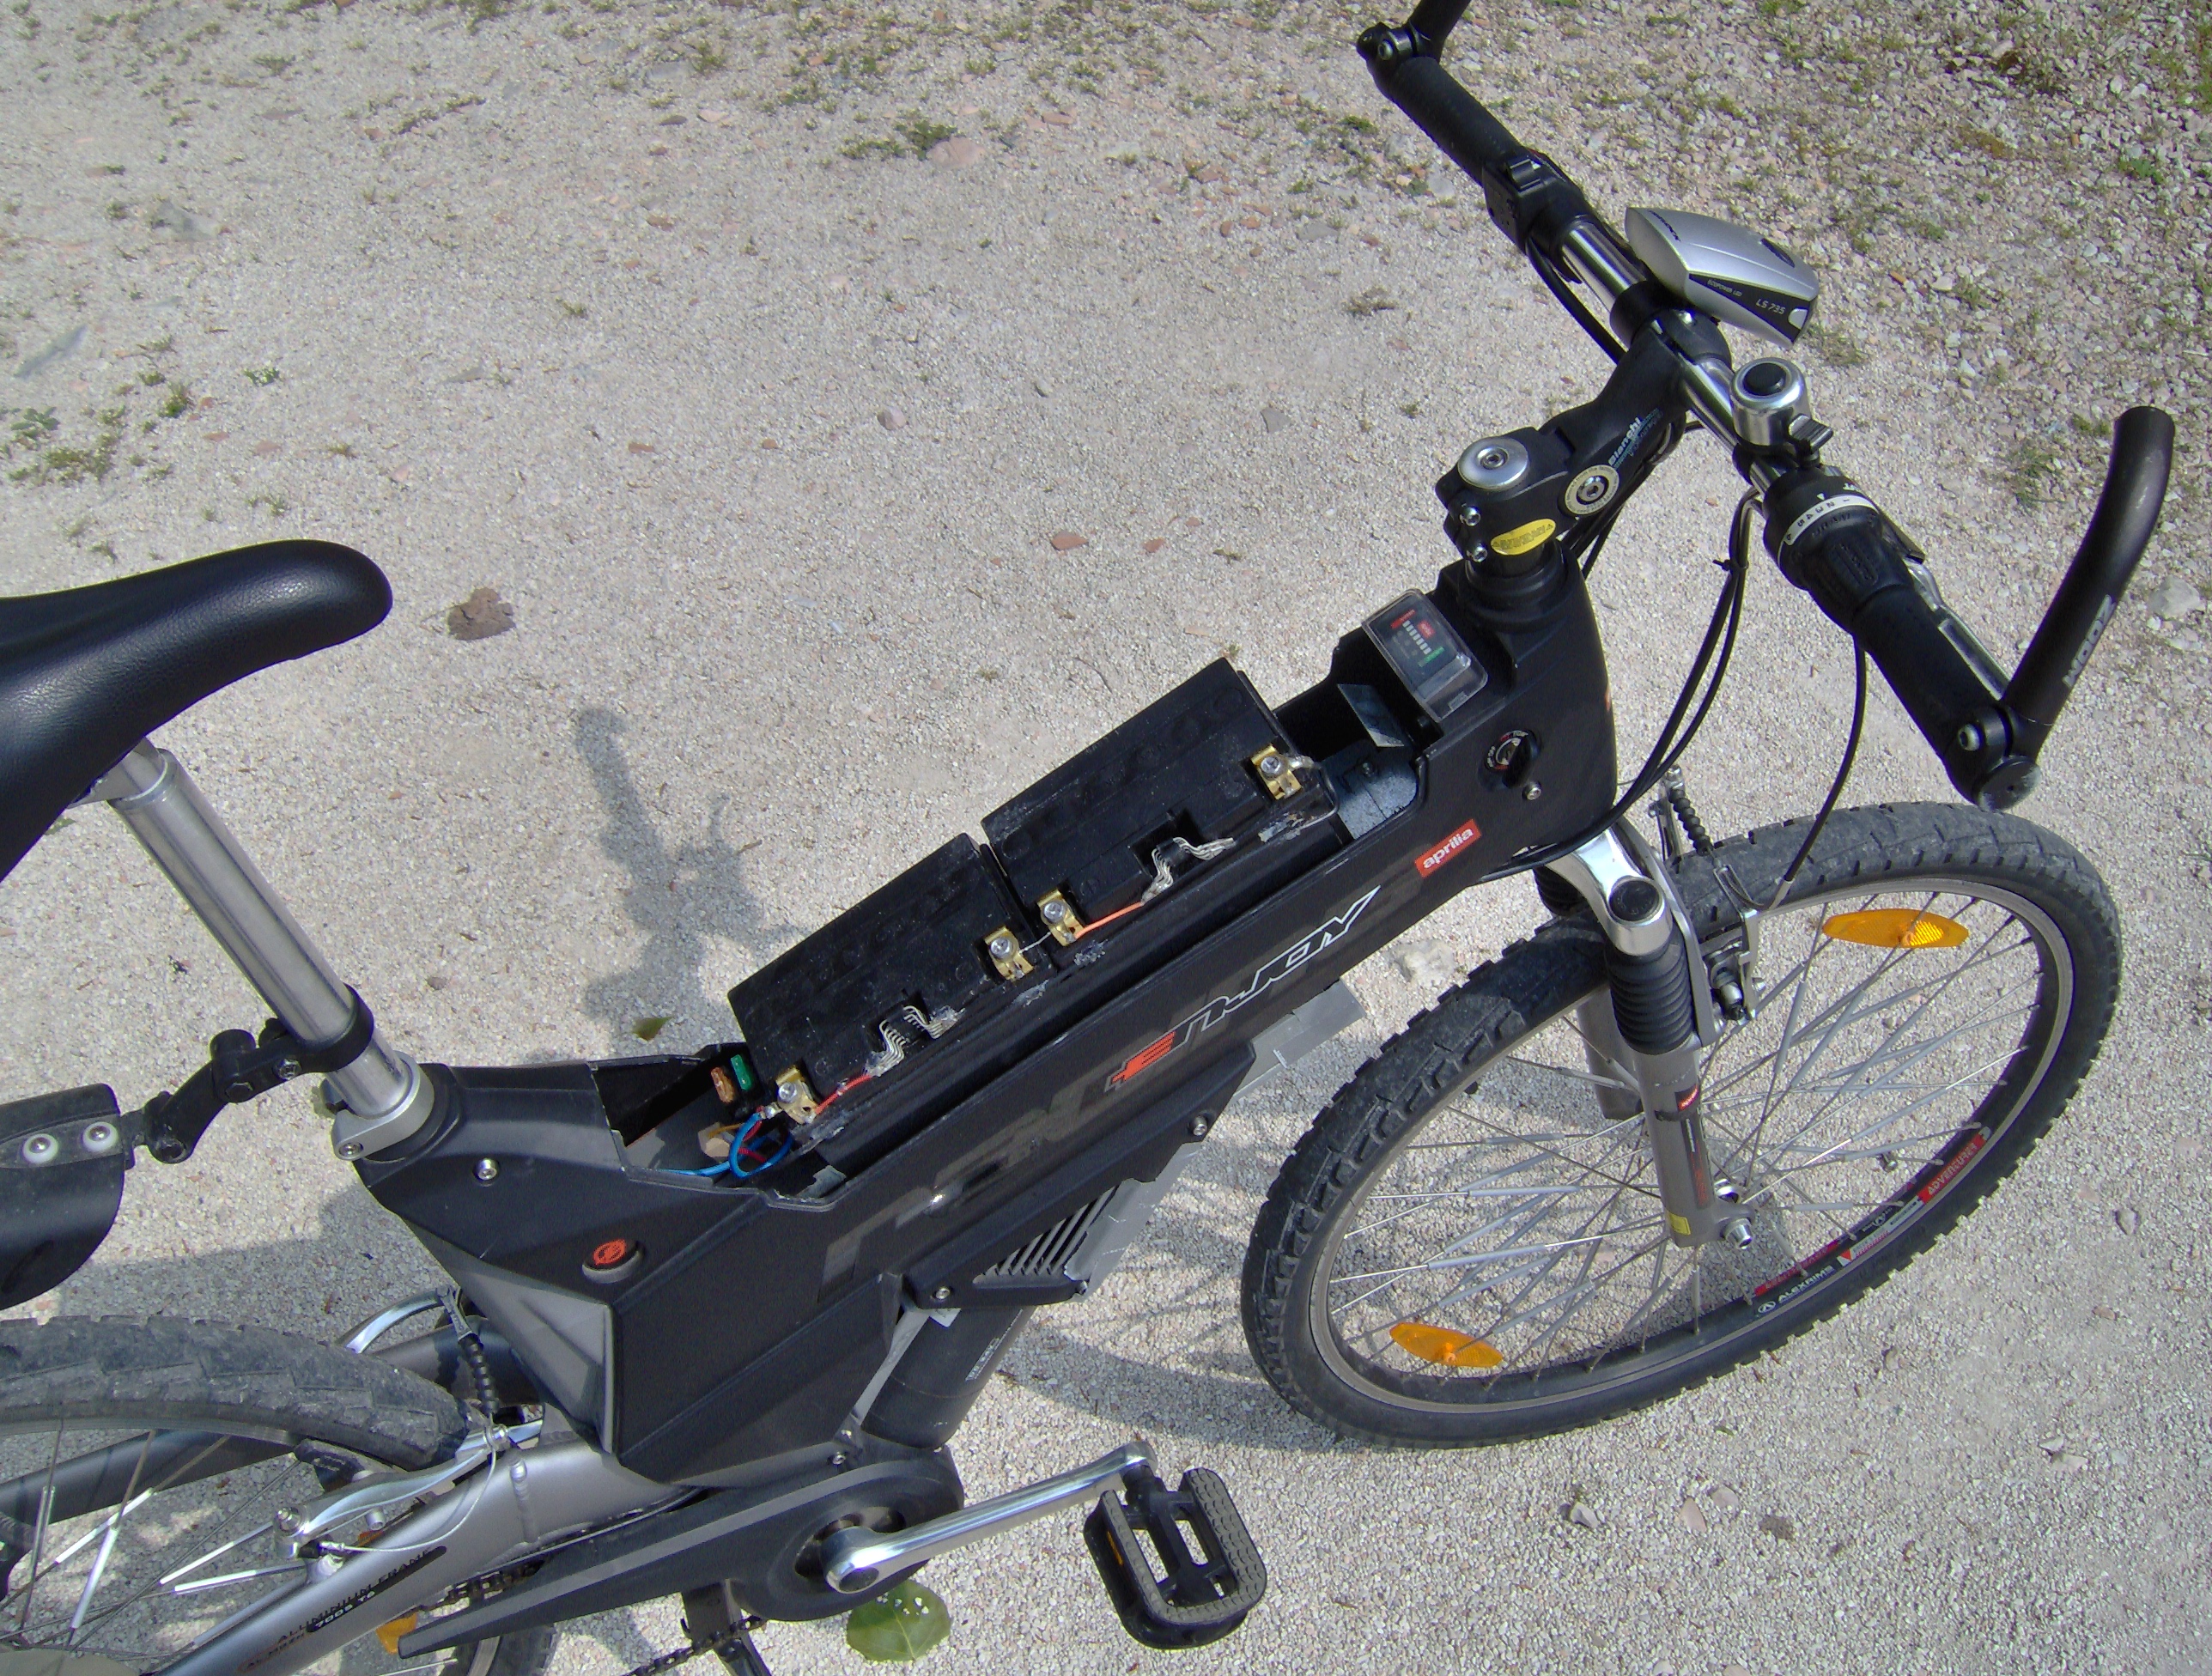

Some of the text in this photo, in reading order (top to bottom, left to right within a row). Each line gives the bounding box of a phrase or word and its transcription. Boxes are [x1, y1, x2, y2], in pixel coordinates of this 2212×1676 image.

[1755, 298, 1787, 315] LS 735
[2062, 593, 2118, 688] ZOOM
[1422, 828, 1474, 869] aprilia
